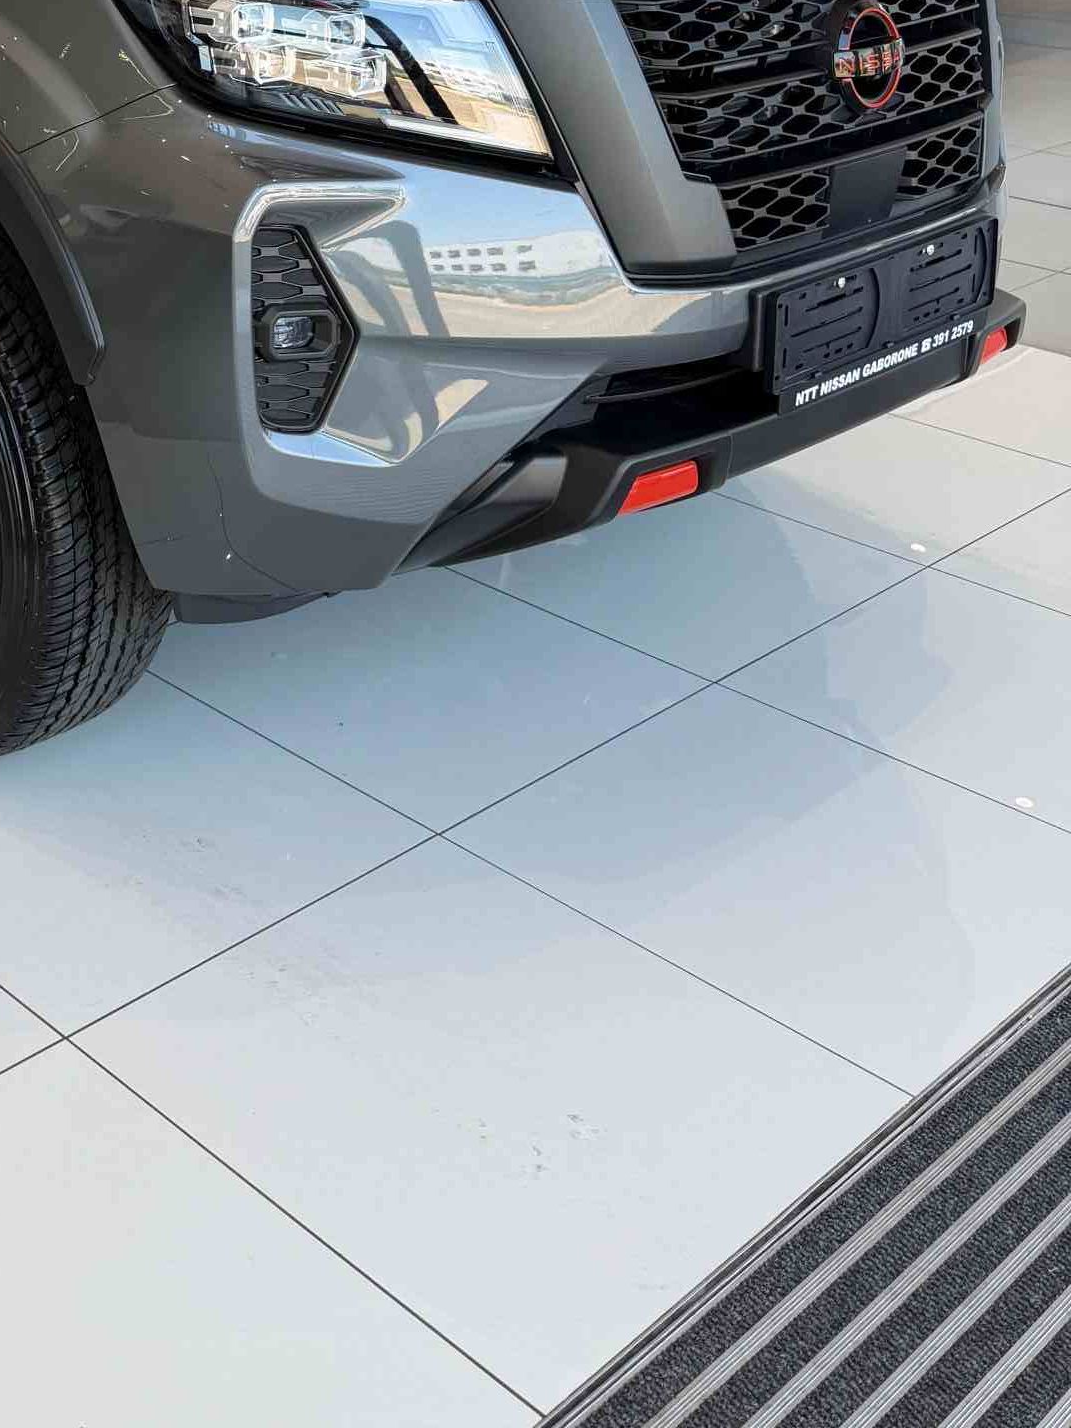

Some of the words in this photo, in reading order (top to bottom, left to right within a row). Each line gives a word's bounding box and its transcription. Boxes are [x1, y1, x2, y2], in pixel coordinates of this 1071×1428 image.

[838, 50, 901, 74] NIS
[796, 384, 819, 406] NTT
[820, 368, 861, 396] NISSAN
[862, 343, 918, 377] GABORONE
[932, 331, 950, 347] 391
[951, 320, 974, 340] 2579
